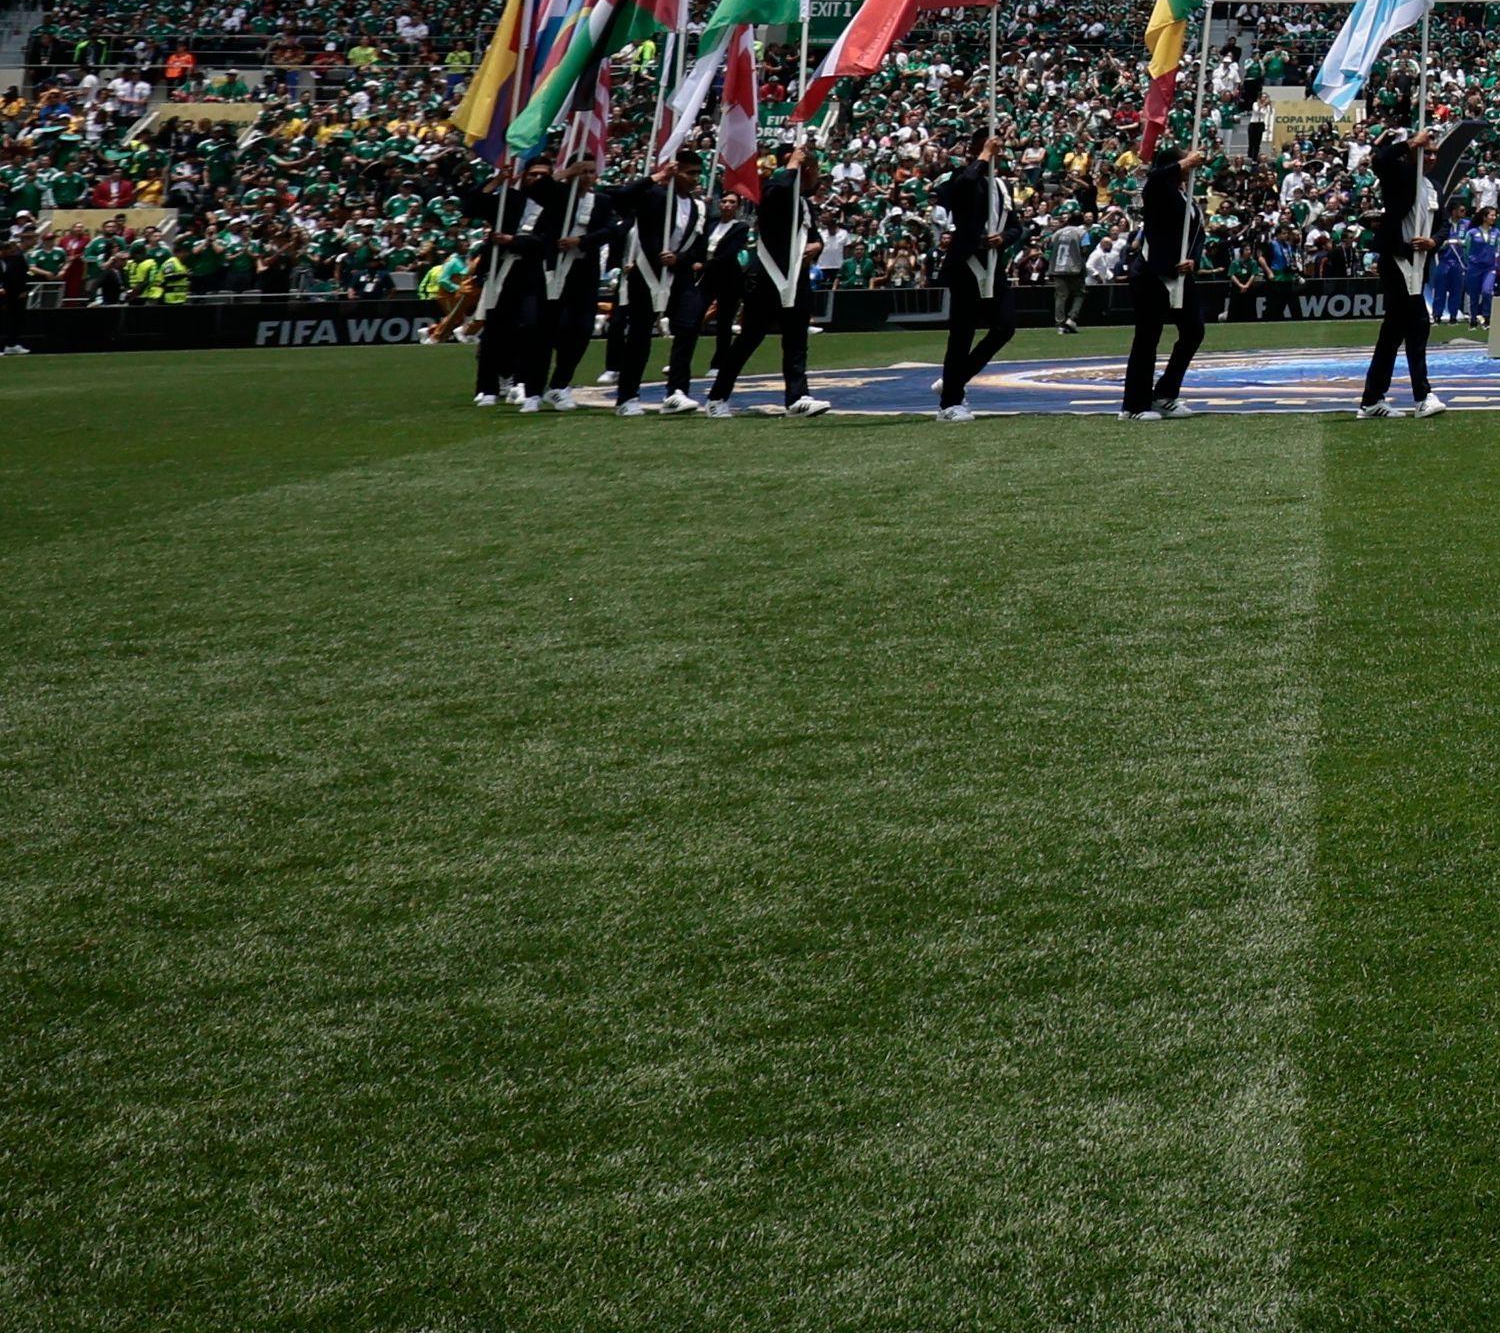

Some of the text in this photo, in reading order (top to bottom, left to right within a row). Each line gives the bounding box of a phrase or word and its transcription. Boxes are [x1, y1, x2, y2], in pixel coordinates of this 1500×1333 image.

[810, 1, 853, 17] EXIT 1
[1276, 116, 1304, 124] COPA
[1299, 294, 1386, 318] WORL
[255, 317, 437, 345] FIFA WOR
